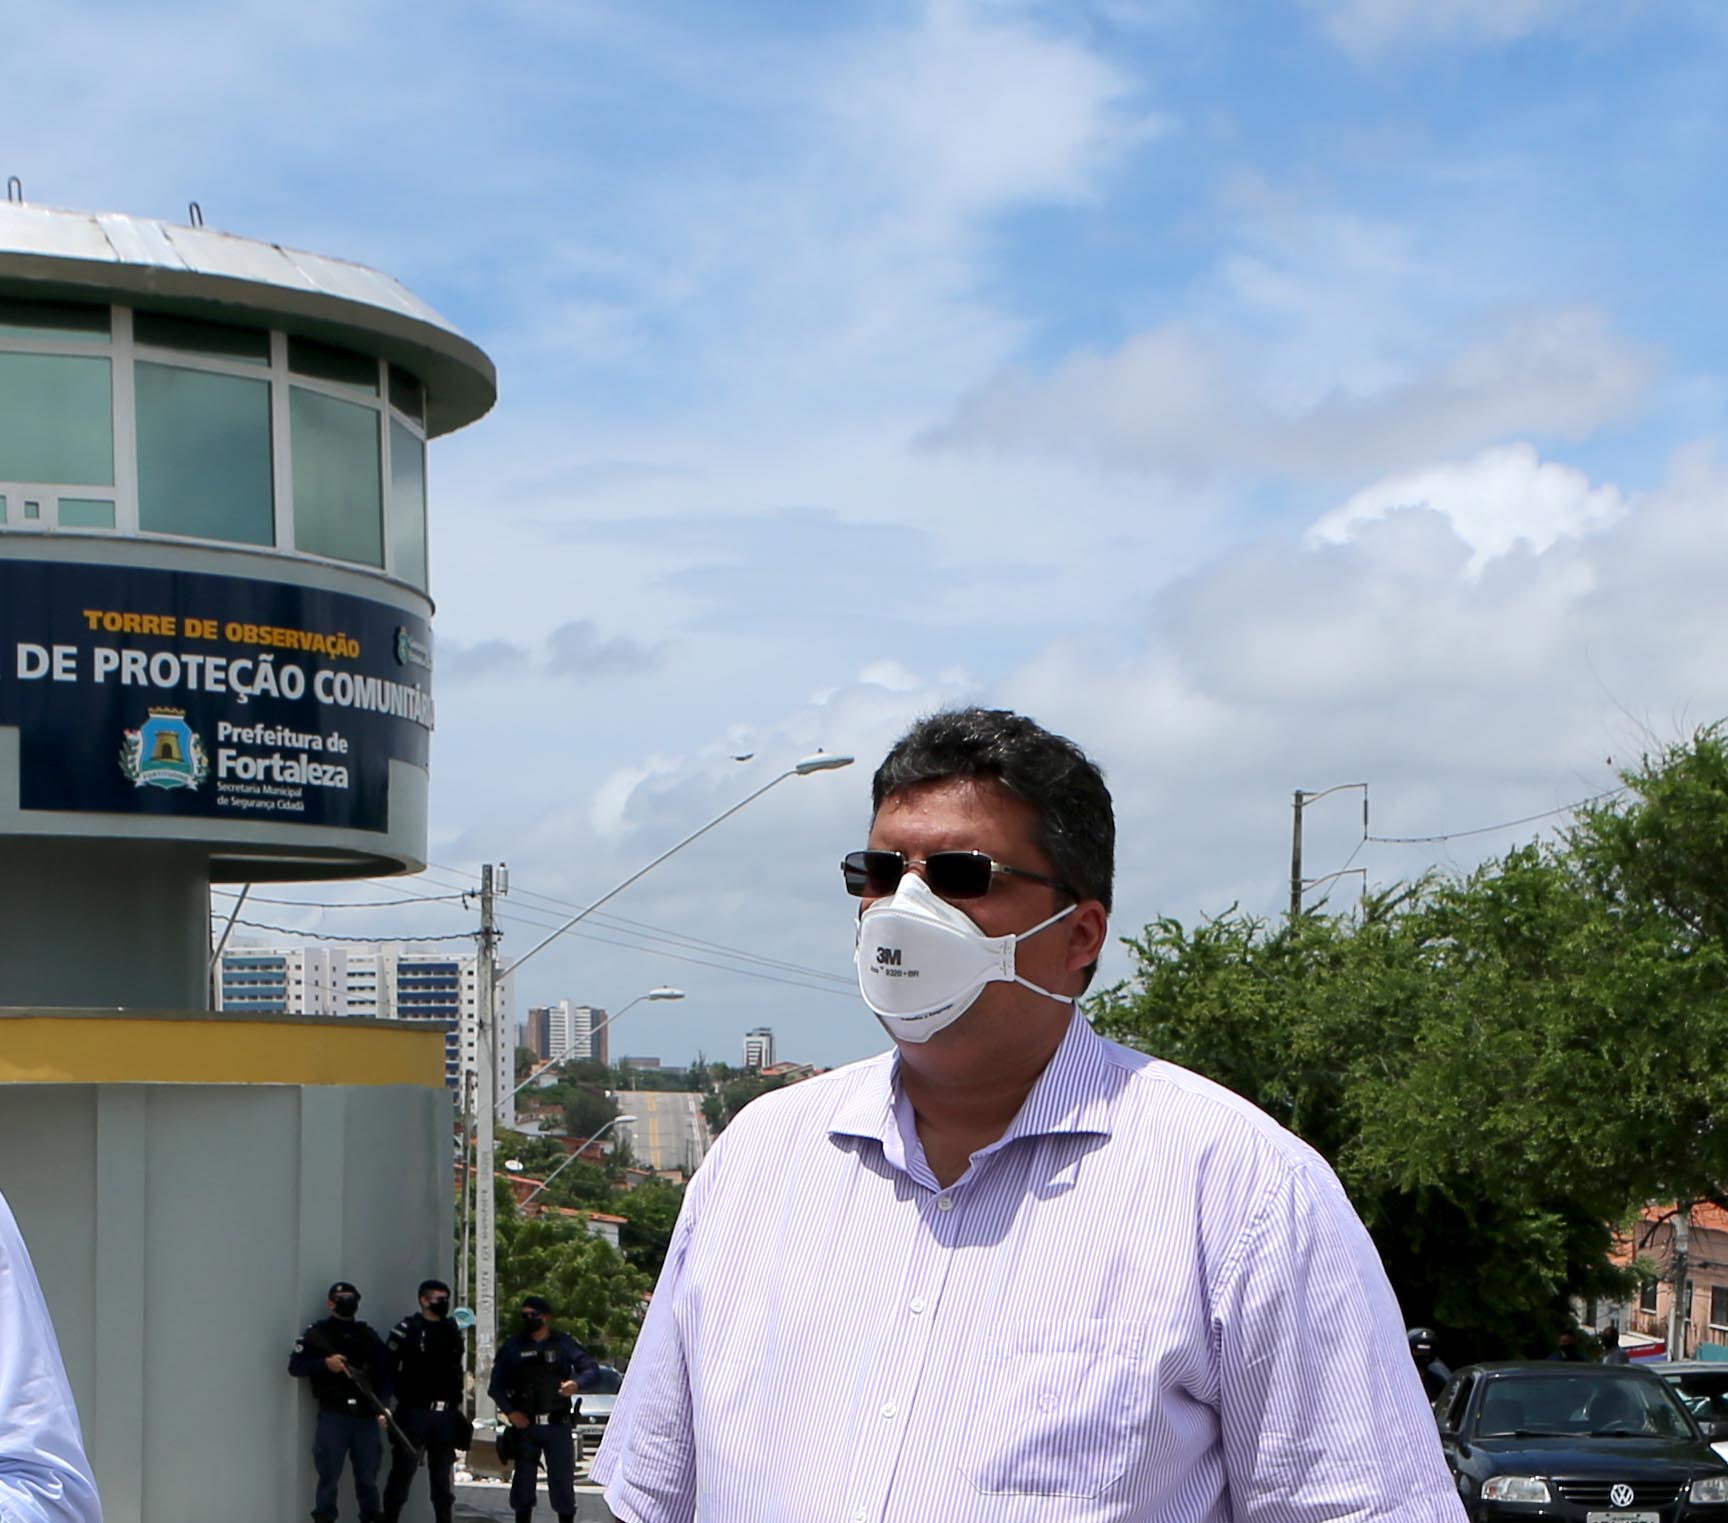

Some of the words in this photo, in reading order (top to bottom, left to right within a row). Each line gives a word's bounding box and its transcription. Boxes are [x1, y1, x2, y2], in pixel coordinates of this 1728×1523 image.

[83, 610, 176, 637] TORRE
[184, 618, 218, 640] DE
[225, 621, 360, 660] OBSERVAÇÃO
[16, 642, 78, 682] DE
[93, 646, 305, 704] PROTEÇÃO
[217, 721, 323, 751] Prefeitura
[325, 731, 349, 754] de
[217, 747, 349, 789] Fortaleza
[216, 780, 261, 795] Secretaria
[262, 784, 303, 799] Municipal
[216, 794, 230, 806] de
[230, 795, 275, 812] Segurança
[876, 946, 902, 966] 3M
